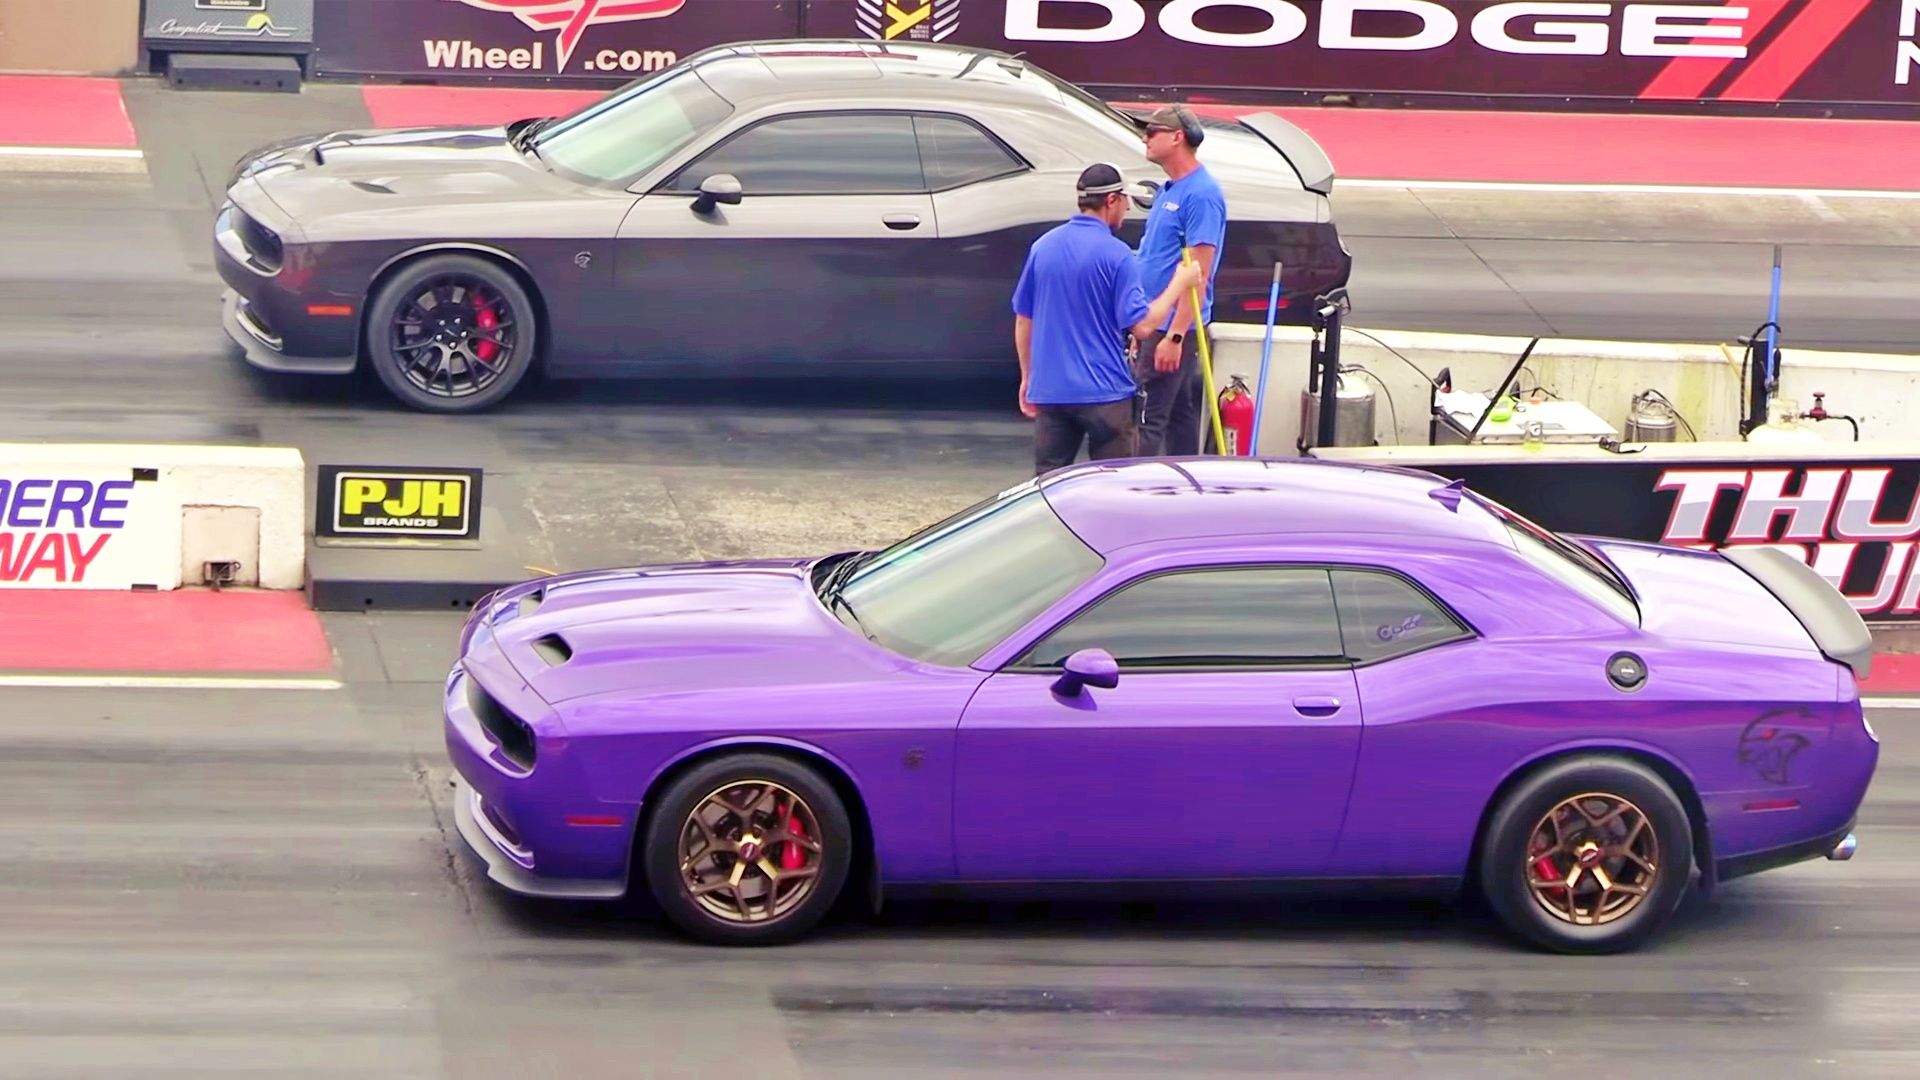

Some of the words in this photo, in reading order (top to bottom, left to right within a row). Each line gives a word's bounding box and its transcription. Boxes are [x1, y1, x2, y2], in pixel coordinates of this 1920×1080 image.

[1004, 0, 1749, 59] DODGE
[423, 39, 543, 70] Wheel
[584, 49, 677, 72] .com
[343, 478, 462, 517] PJH
[363, 516, 439, 527] BRANDS
